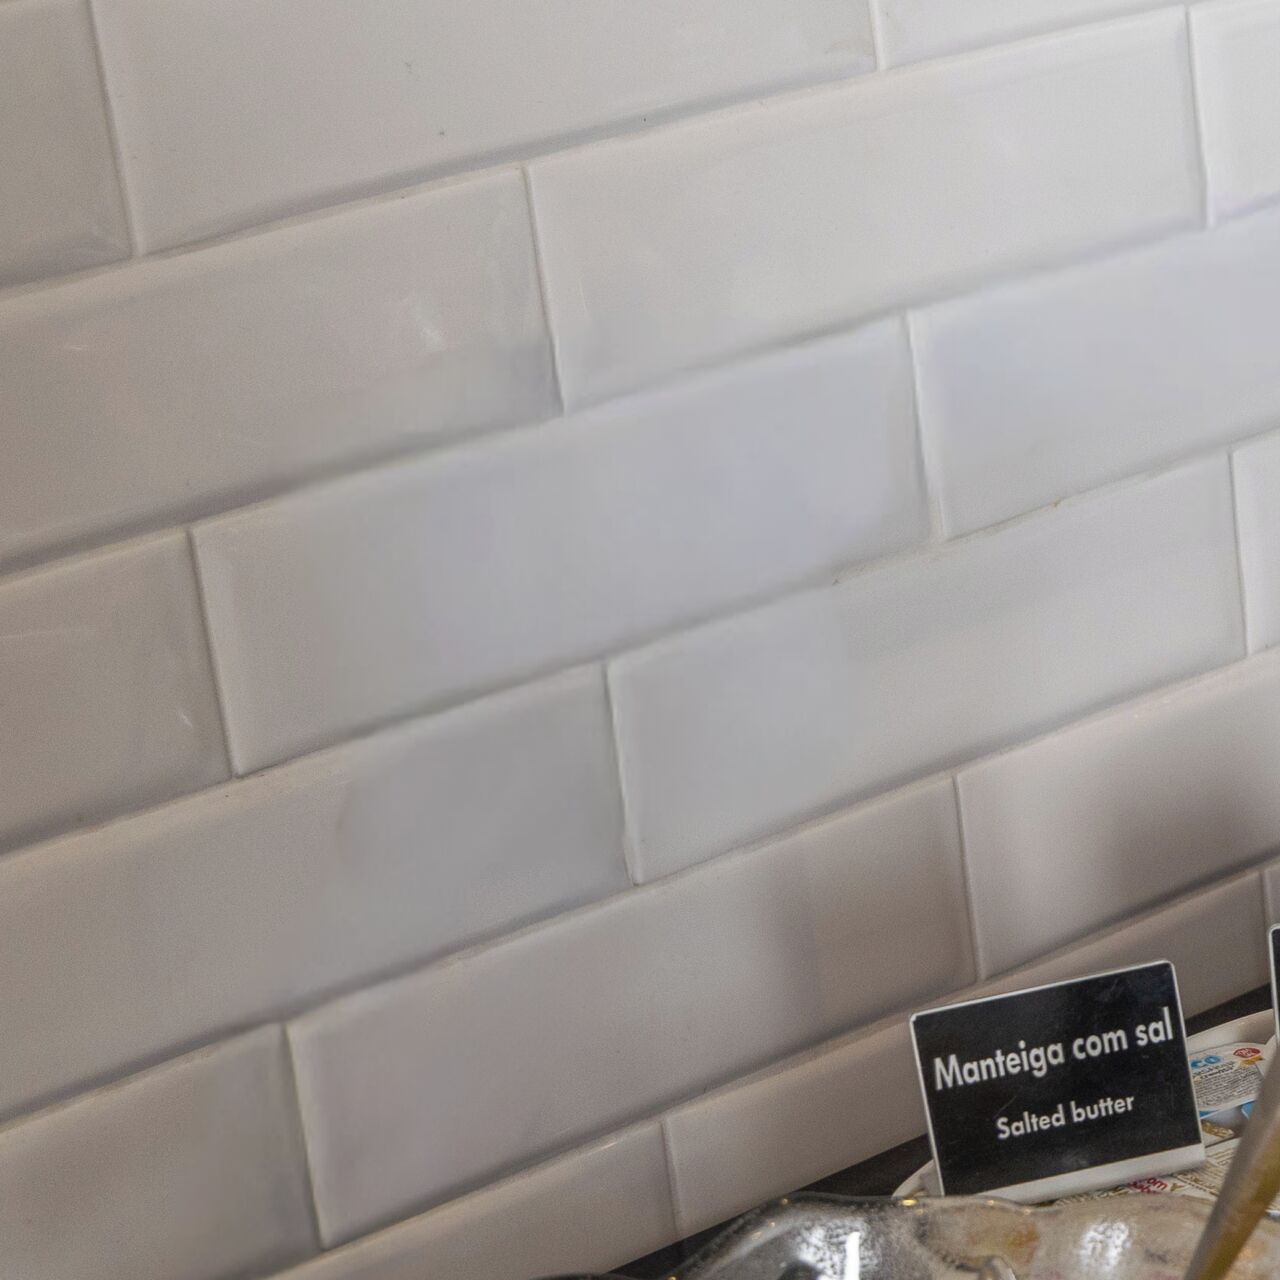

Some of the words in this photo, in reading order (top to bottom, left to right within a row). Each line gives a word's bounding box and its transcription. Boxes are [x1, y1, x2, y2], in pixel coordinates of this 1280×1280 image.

[934, 1040, 1065, 1091] Manteiga
[1072, 1027, 1129, 1062] com
[1135, 1006, 1175, 1047] sal
[996, 1101, 1067, 1141] Salted
[1069, 1092, 1136, 1128] butter
